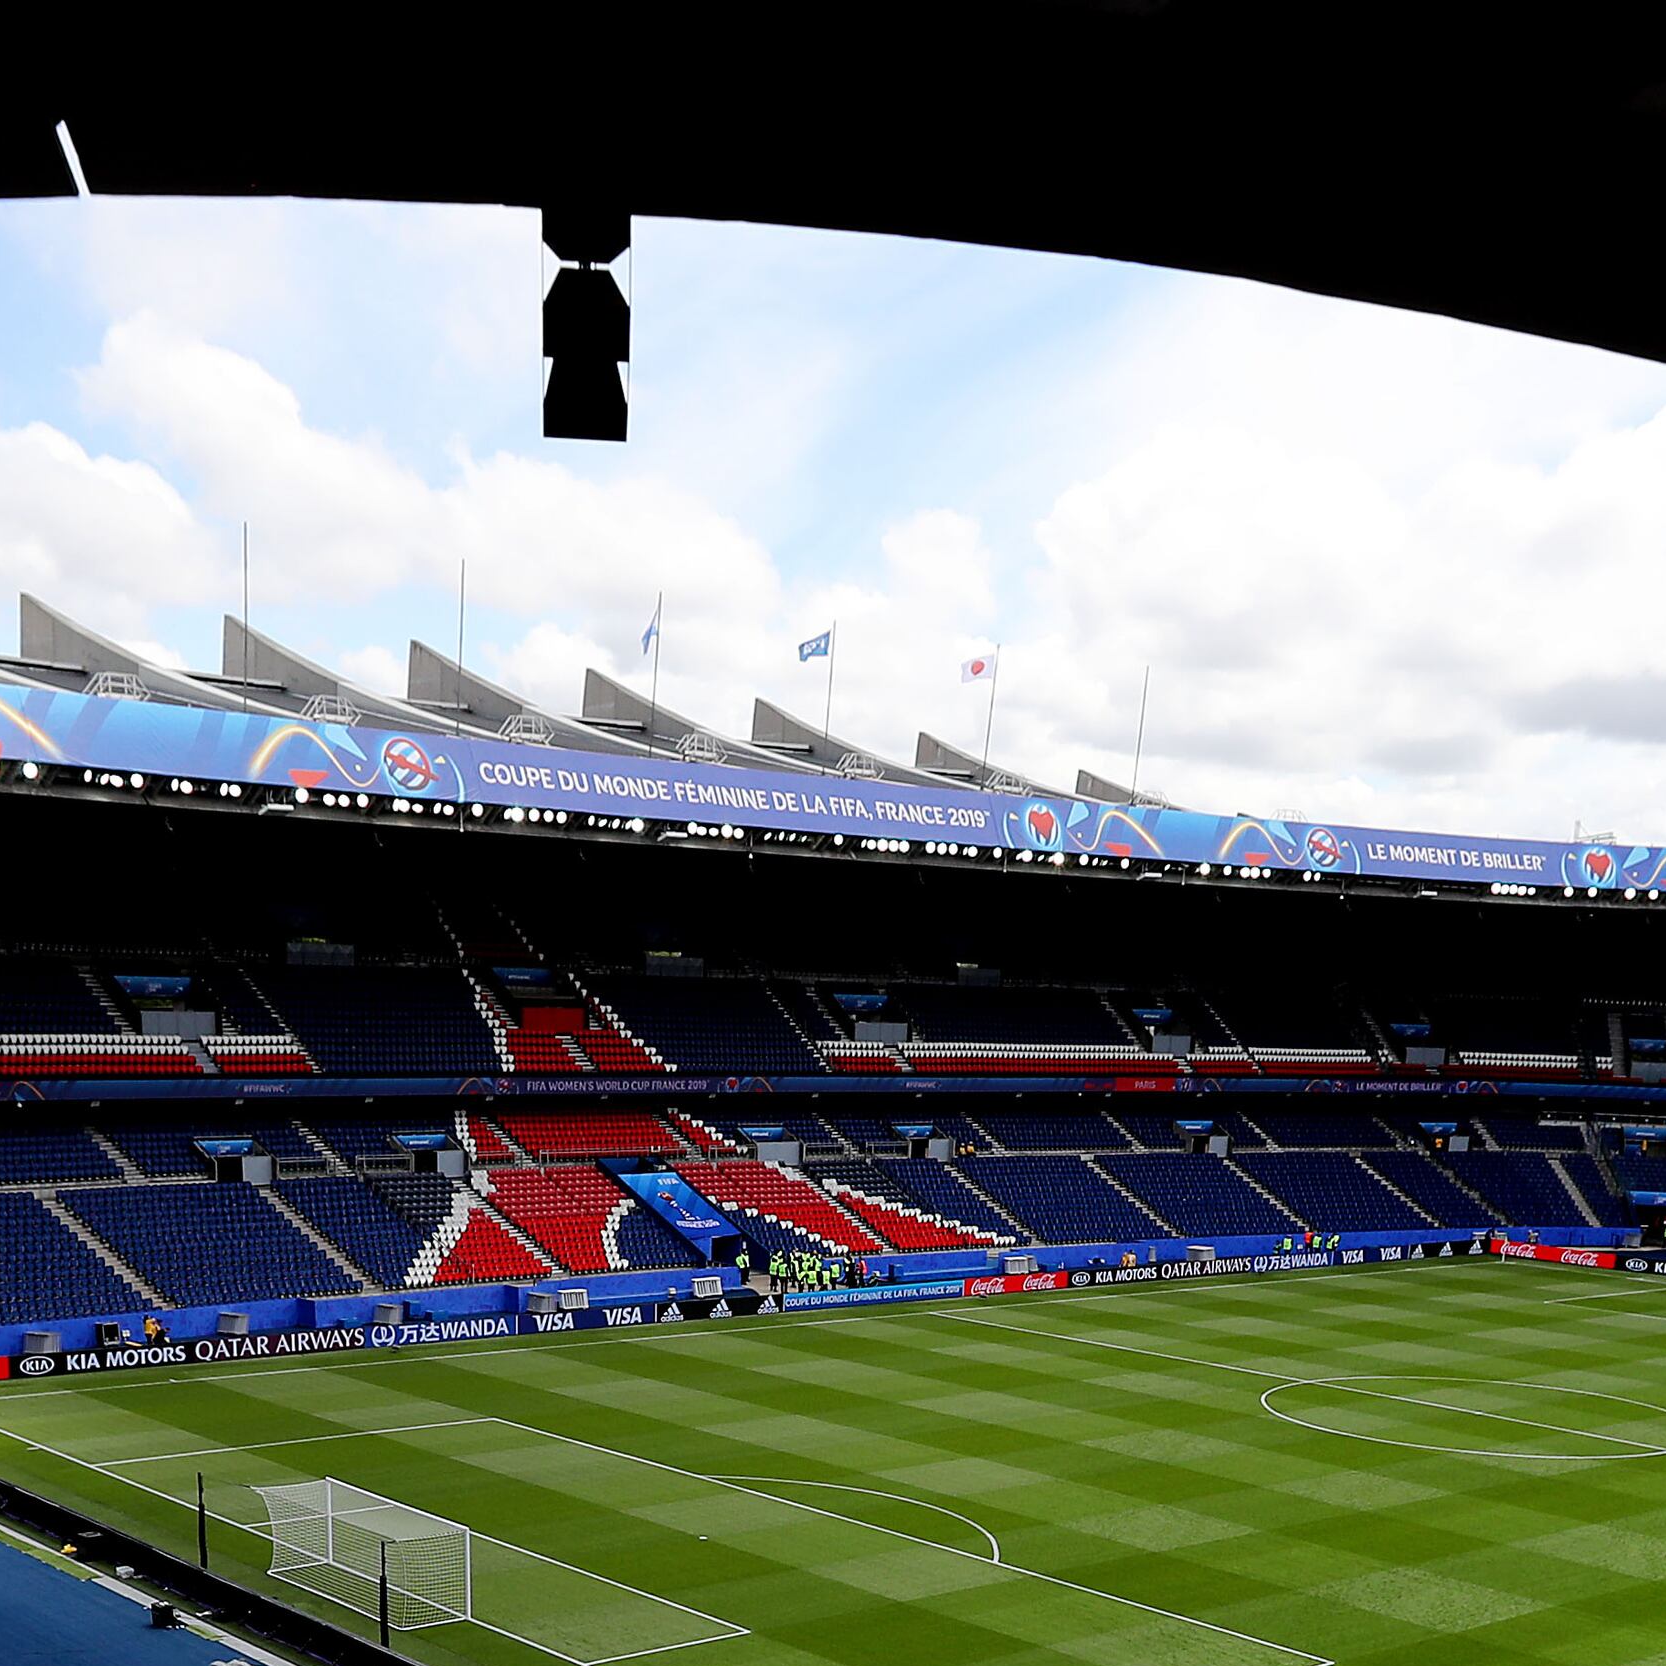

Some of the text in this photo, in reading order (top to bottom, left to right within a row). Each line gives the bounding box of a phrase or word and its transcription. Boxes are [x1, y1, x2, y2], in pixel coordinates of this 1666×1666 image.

[479, 762, 556, 790] COUPE
[558, 772, 590, 793] DU
[594, 774, 671, 801] MONDE
[674, 779, 769, 811] FÉMININE
[772, 791, 799, 813] DE
[800, 794, 831, 815] LA
[829, 796, 873, 821] FIFA,
[875, 801, 946, 827] FRANCE
[1367, 842, 1387, 860] LE
[1389, 844, 1457, 866] MOMENT
[1460, 851, 1482, 868] DE
[527, 1080, 547, 1091] FIFA
[549, 1080, 595, 1092] WOMEN'S
[596, 1079, 630, 1091] WORLD
[630, 1079, 650, 1091] CUP
[651, 1079, 687, 1091] FRANCE
[1134, 1080, 1157, 1090] PARIS
[1290, 1250, 1328, 1268] WANDA
[1342, 1250, 1364, 1264] VISA
[1380, 1247, 1402, 1261] VISA
[1095, 1266, 1157, 1284] KIA MOTORS
[1161, 1256, 1251, 1279] QATAR AIRWAYS
[785, 1297, 808, 1308] COUPE
[810, 1296, 821, 1306] DU
[822, 1294, 848, 1305] MONDE
[883, 1291, 893, 1300] DE
[894, 1290, 904, 1299] LA
[919, 1286, 945, 1297] FRANCE
[532, 1312, 575, 1332] VISA
[602, 1306, 643, 1327] VISA
[399, 1323, 440, 1344] 万达
[440, 1317, 509, 1340] WANDA
[195, 1327, 365, 1362] QATAR AIRWAYS
[66, 1345, 186, 1371] KIA MOTORS
